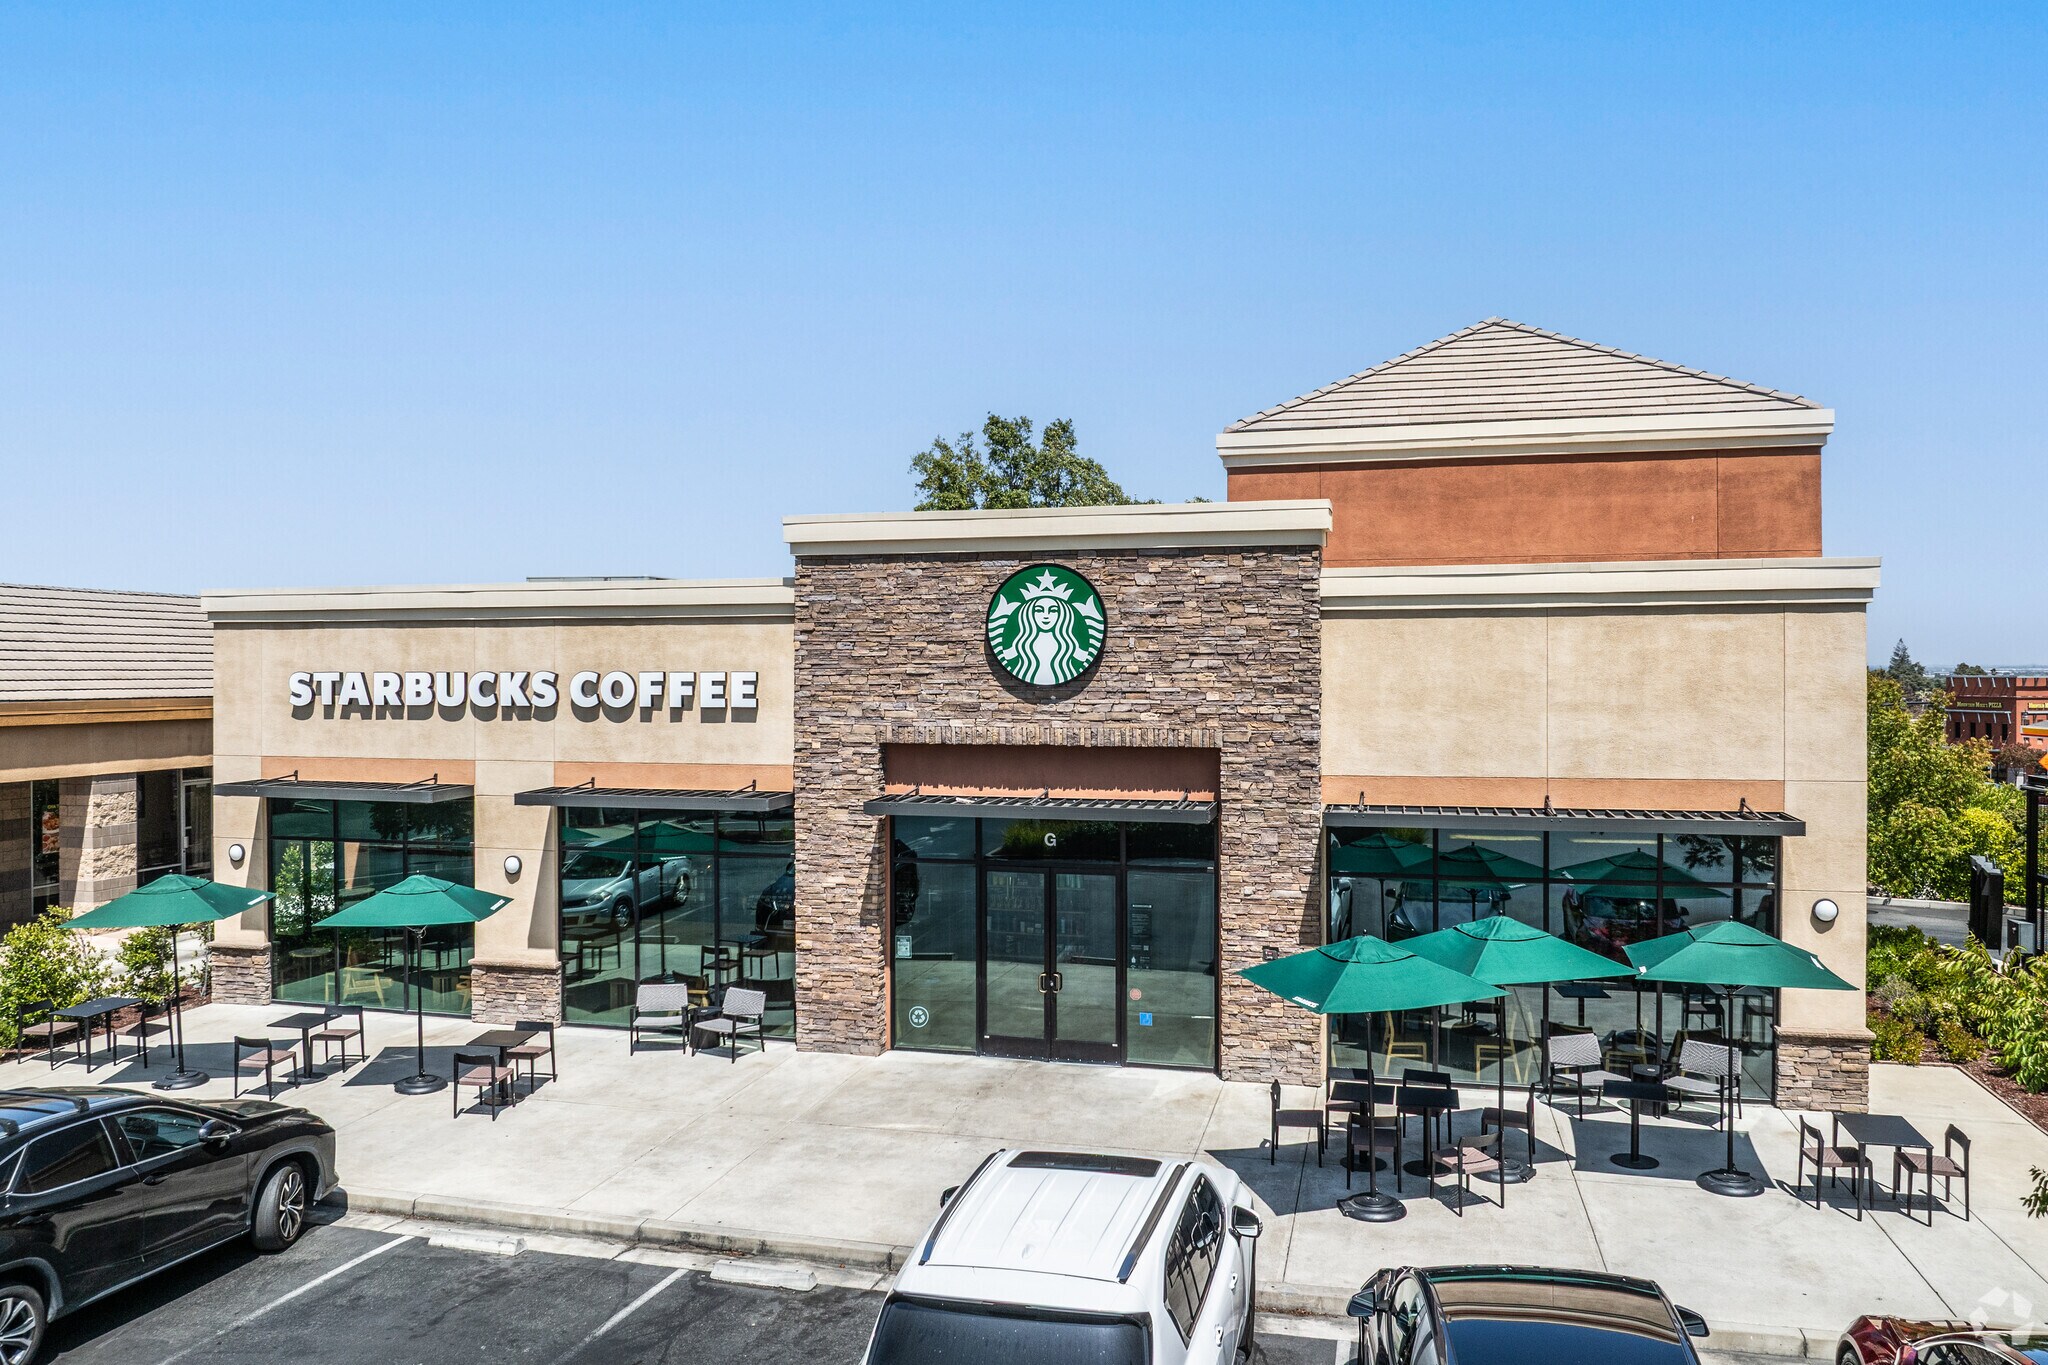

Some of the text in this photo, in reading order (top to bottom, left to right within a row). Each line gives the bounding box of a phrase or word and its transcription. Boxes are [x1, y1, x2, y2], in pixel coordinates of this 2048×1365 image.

[288, 671, 758, 709] STARBUCKS COFFEE
[1044, 832, 1057, 846] G
